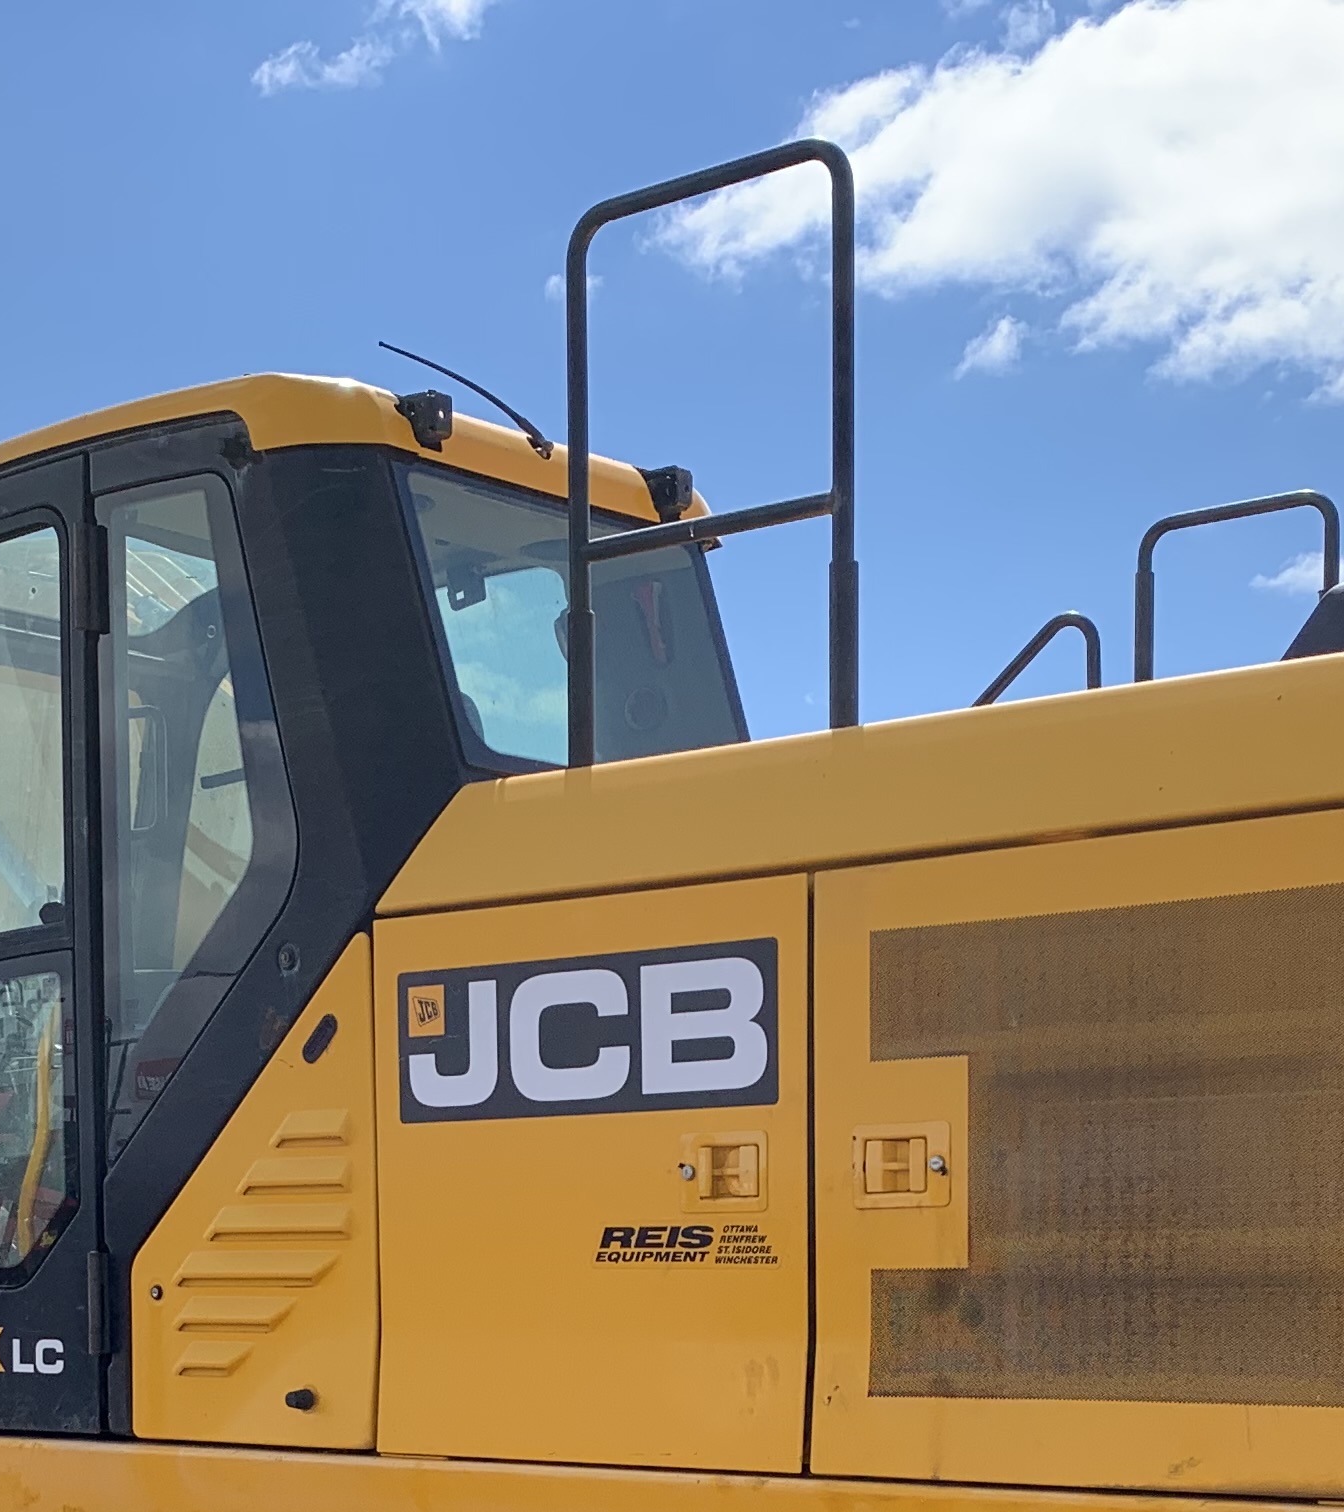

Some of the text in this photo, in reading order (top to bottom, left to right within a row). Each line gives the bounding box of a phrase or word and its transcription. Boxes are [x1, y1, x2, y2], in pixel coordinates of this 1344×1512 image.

[417, 999, 439, 1023] JCB
[409, 957, 769, 1108] JCB
[722, 1224, 759, 1234] OTTAWA
[599, 1225, 715, 1249] REIS
[719, 1235, 768, 1244] RENFREW
[732, 1245, 773, 1254] ISIDORE
[595, 1251, 711, 1264] EQUIPMENT
[714, 1255, 779, 1265] WINCHESTER
[12, 1338, 65, 1375] LC
